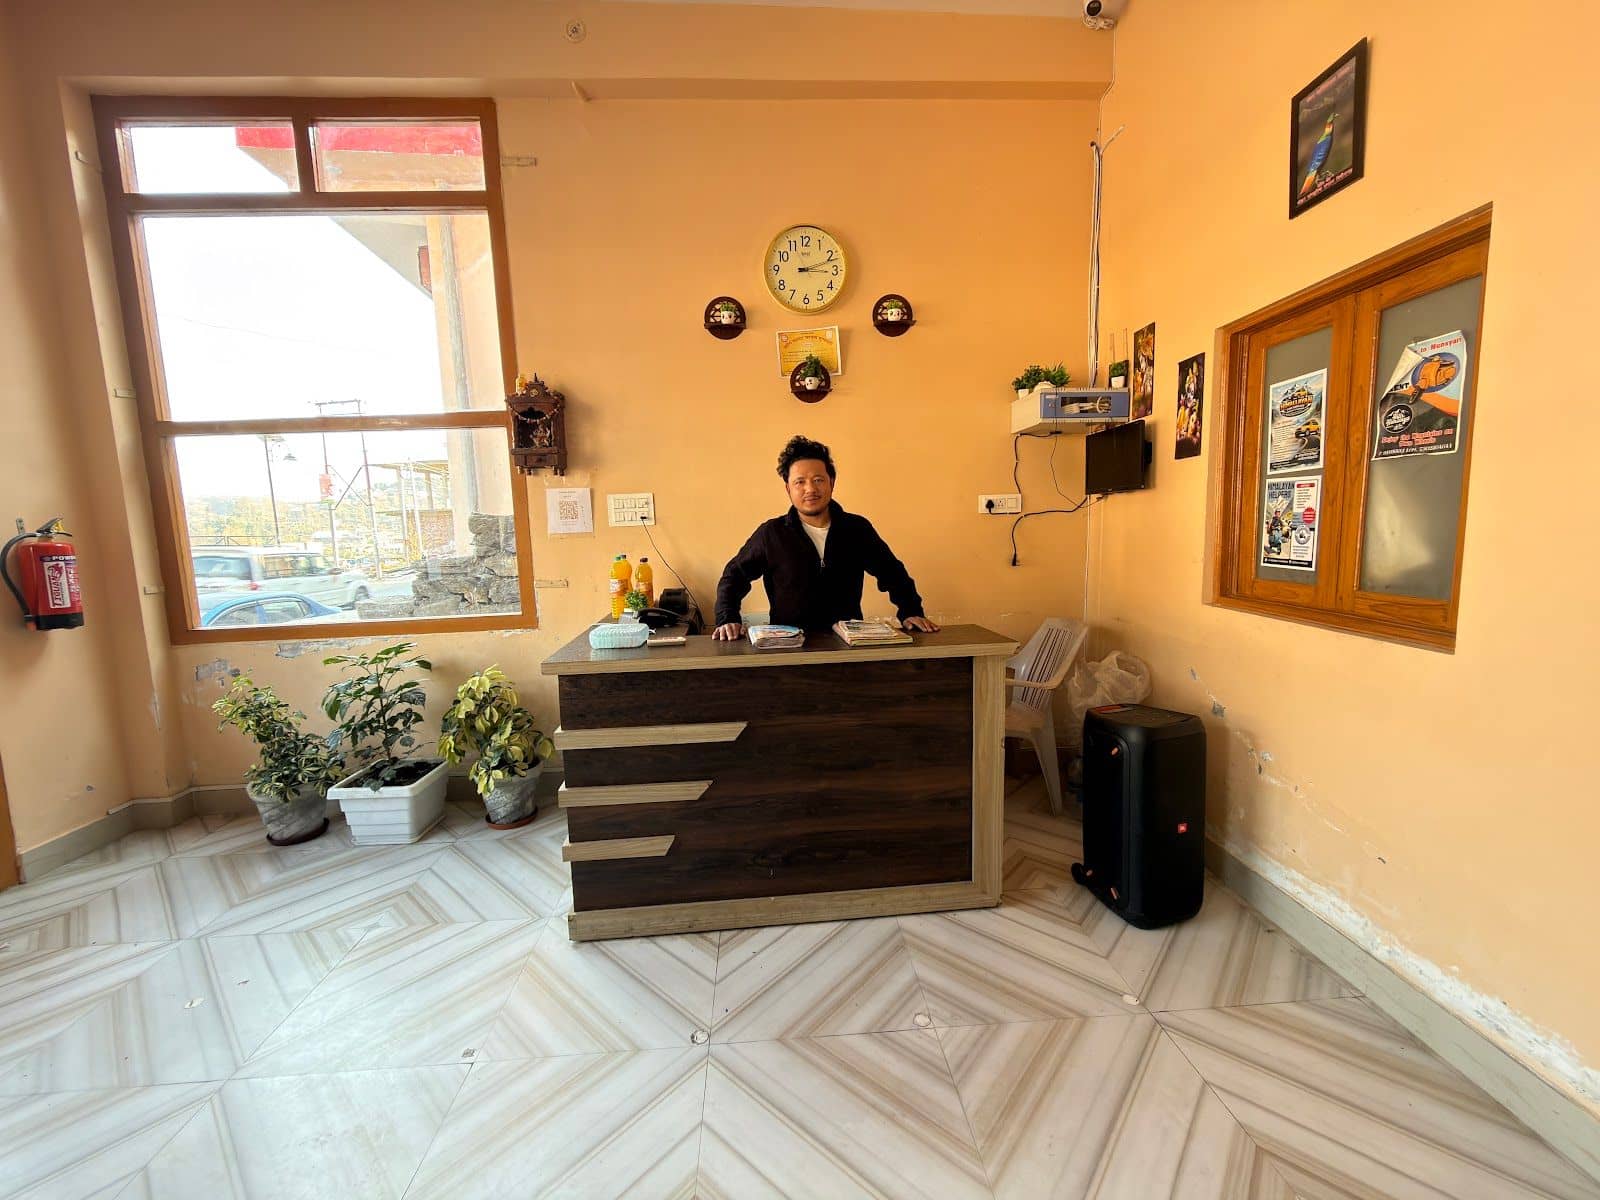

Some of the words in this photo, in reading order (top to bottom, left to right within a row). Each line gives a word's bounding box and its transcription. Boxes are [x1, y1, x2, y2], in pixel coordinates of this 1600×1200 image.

[788, 240, 796, 252] 11
[800, 236, 810, 246] 12
[778, 250, 788, 262] 10
[826, 250, 834, 260] 2
[774, 264, 780, 276] 9
[832, 266, 838, 276] 3
[778, 280, 786, 290] 8
[828, 280, 834, 290] 4
[790, 290, 796, 300] 7
[804, 294, 810, 304] 6
[818, 290, 824, 300] 5
[1267, 482, 1295, 491] HIMALAYAN
[1268, 490, 1292, 500] HELPERS
